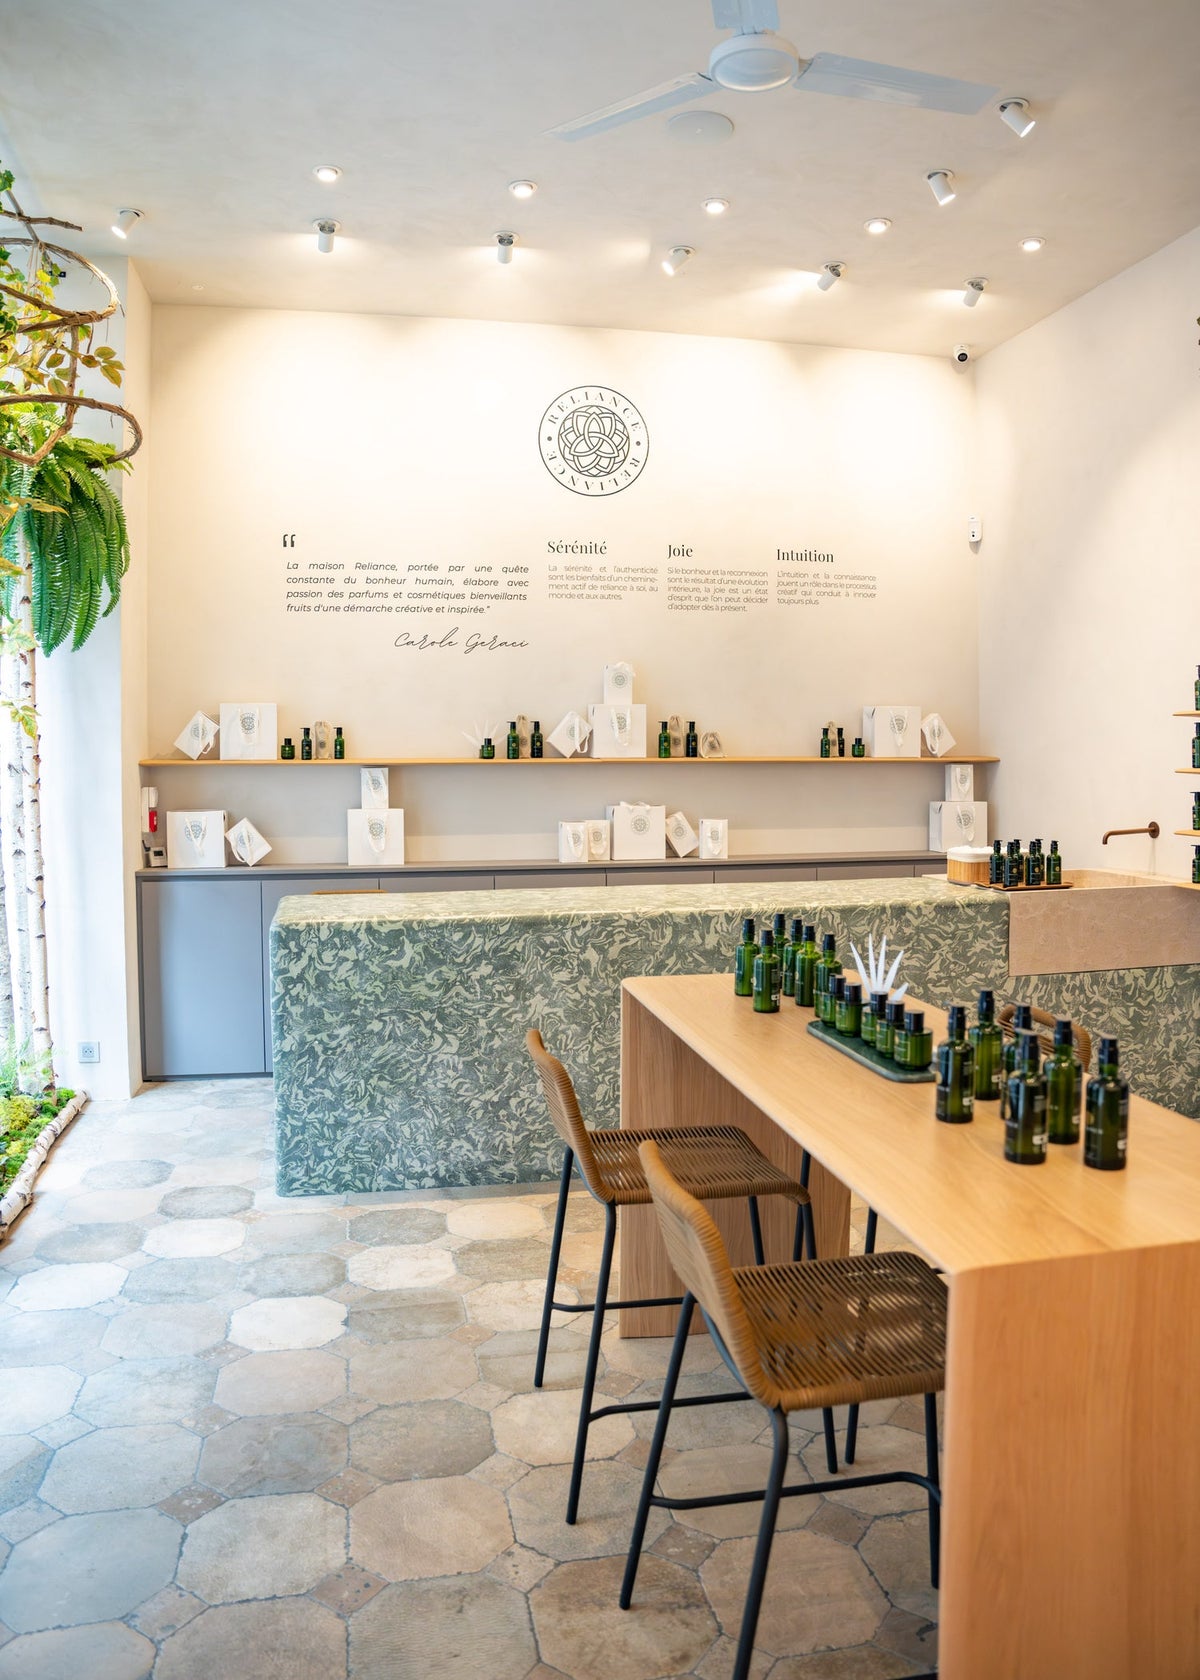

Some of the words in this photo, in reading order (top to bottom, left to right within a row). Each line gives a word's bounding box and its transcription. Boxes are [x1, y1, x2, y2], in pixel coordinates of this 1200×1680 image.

[548, 391, 641, 432] RELIANCE
[547, 450, 640, 491] RELIANCE
[548, 540, 607, 554] Sérénité
[667, 545, 693, 559] Joie
[777, 549, 834, 562] Intuition
[309, 562, 345, 570] maison
[355, 562, 398, 571] Reliance,
[407, 564, 439, 572] portée
[502, 566, 529, 574] quête
[415, 578, 455, 586] humain,
[463, 578, 499, 586] élabore
[624, 575, 658, 583] chemine-
[286, 590, 322, 599] passion
[328, 590, 344, 598] des
[349, 590, 388, 599] parfums
[407, 592, 465, 600] cosmétiques
[470, 592, 527, 600] bienveillants
[287, 604, 311, 612] fruits
[314, 604, 341, 612] d'une
[395, 604, 433, 613] créative
[394, 627, 459, 650] Carole
[464, 633, 529, 654] Geraci
